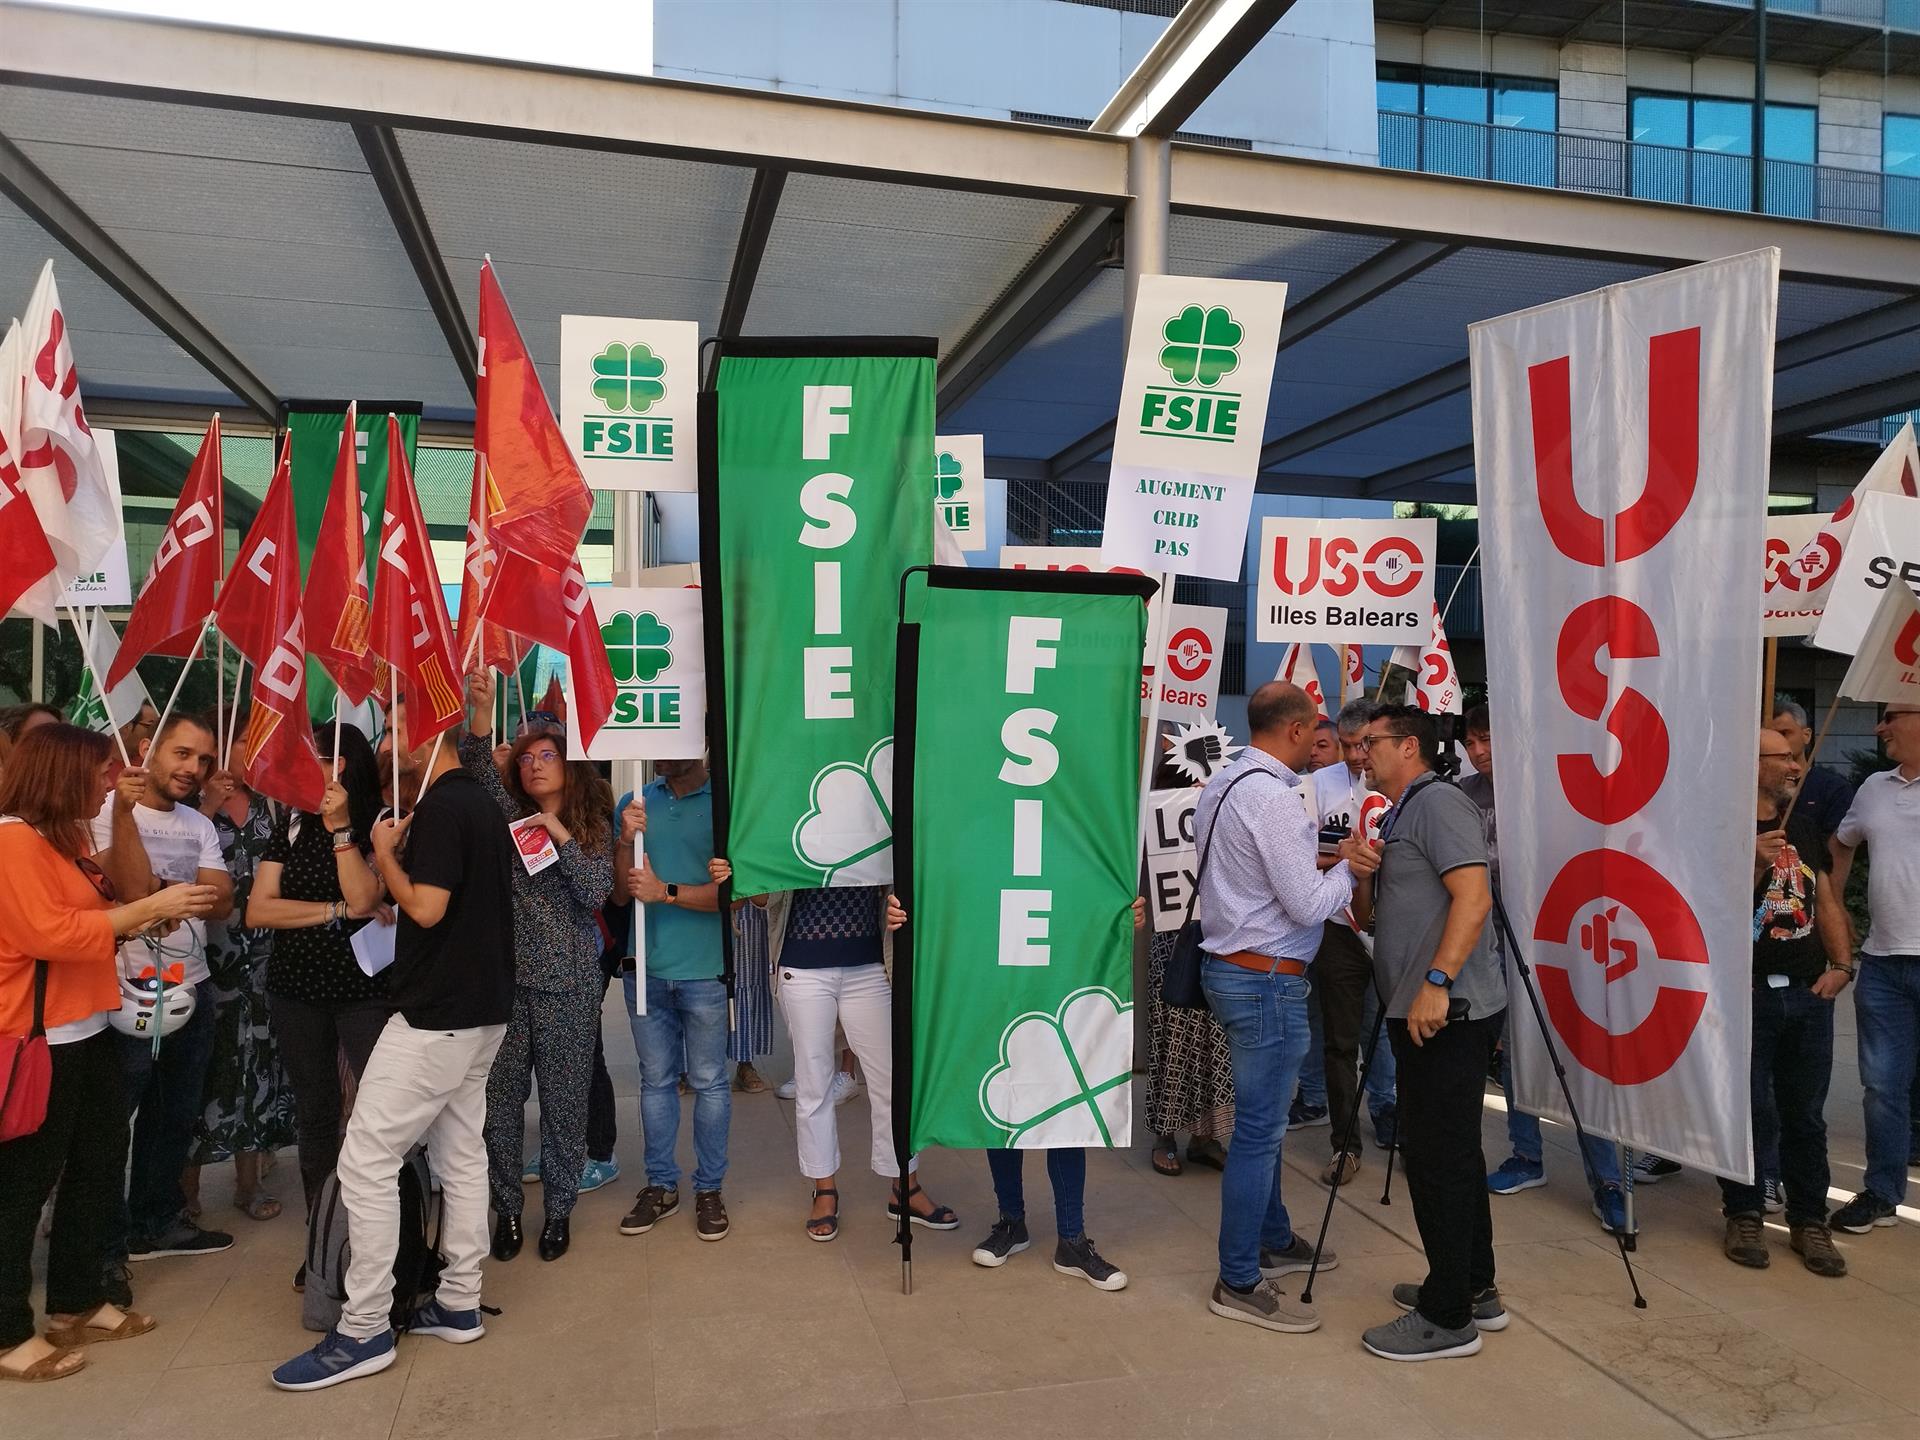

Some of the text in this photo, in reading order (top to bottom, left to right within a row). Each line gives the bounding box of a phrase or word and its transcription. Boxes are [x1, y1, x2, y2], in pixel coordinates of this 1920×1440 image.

[1140, 393, 1241, 436] FSIE
[583, 421, 674, 455] FSIE
[1135, 478, 1226, 502] AUGMENT
[1152, 509, 1200, 529] CRIB
[798, 385, 856, 720] FSIE
[1154, 538, 1190, 558] PAS
[1273, 536, 1425, 598] USO
[1269, 605, 1420, 628] Illes Balears
[613, 692, 681, 724] SIE
[1528, 326, 1709, 1086] USO
[997, 615, 1063, 967] FSIE
